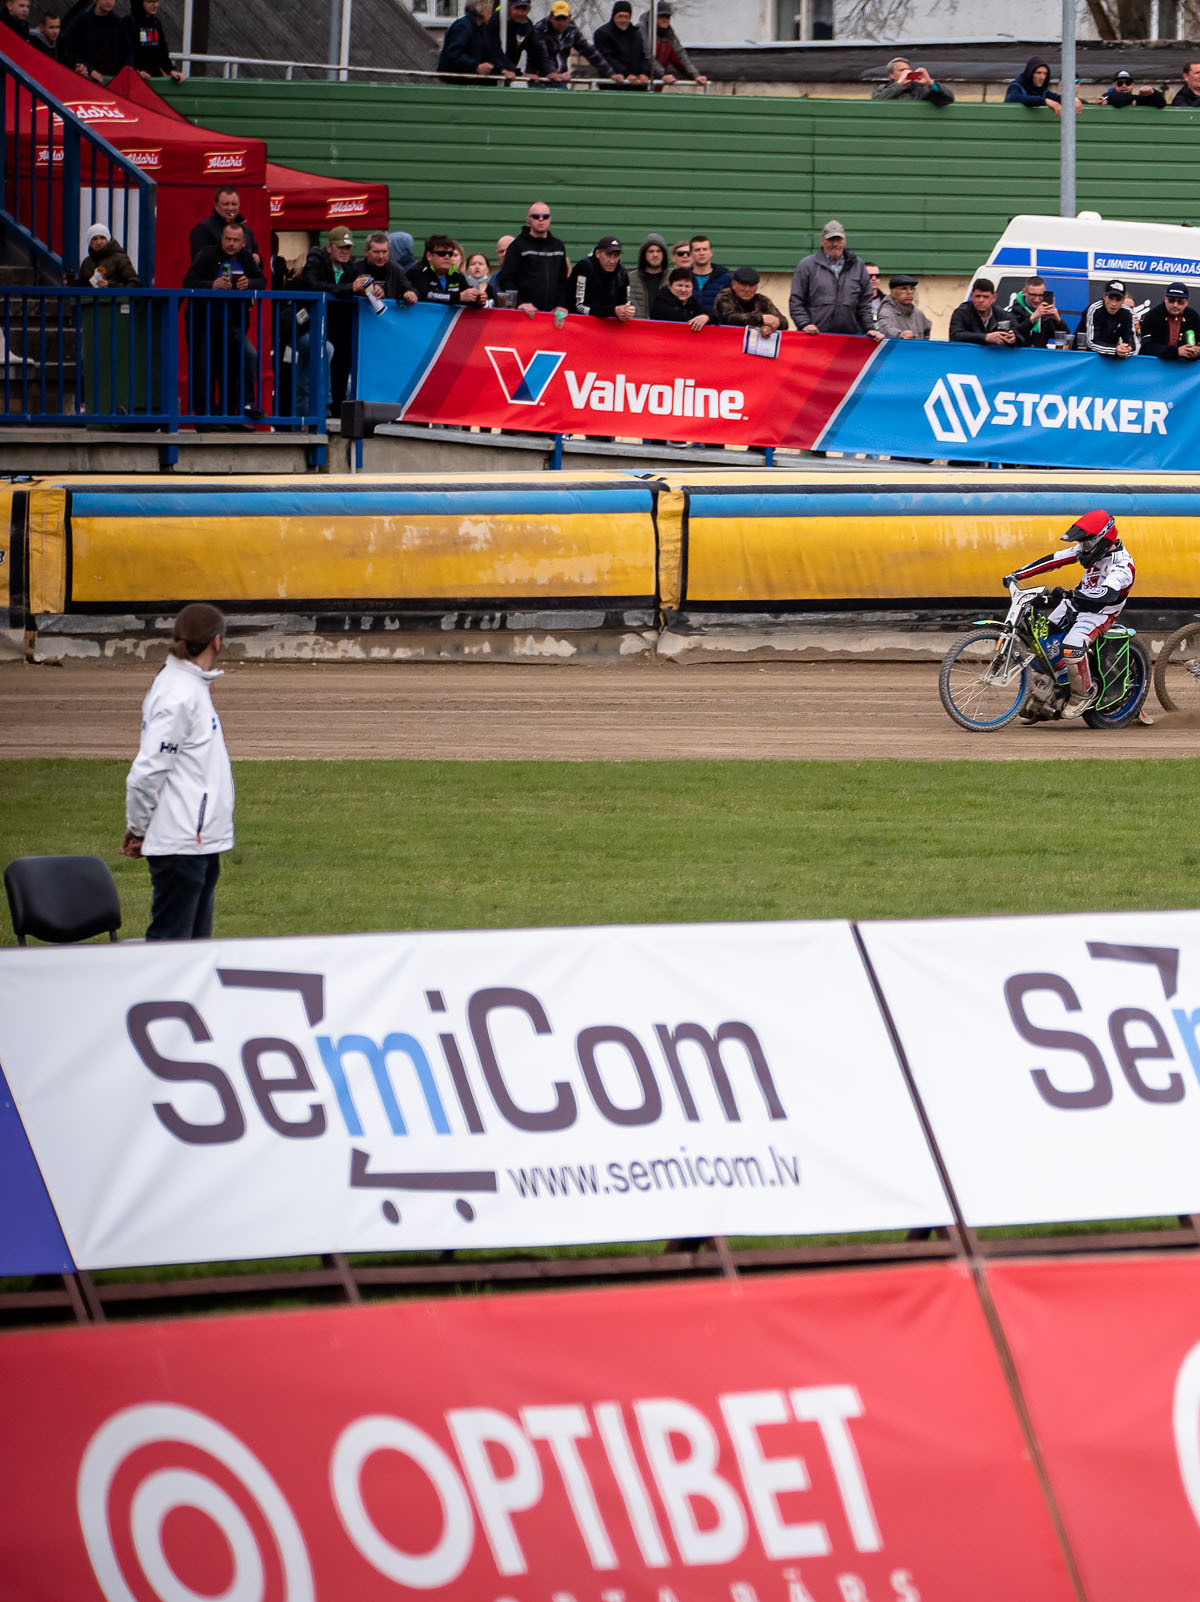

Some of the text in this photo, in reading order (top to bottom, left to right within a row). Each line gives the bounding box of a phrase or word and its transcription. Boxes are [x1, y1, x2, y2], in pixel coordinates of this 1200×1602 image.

[207, 155, 243, 168] Aldaris
[1095, 258, 1147, 271] SLIMNIEKU
[564, 370, 749, 420] Valvoline
[991, 391, 1168, 435] STOKKER
[127, 987, 788, 1146] SemiCom
[508, 1146, 801, 1199] www.semicom.lv
[329, 1384, 884, 1589] OPTIBET
